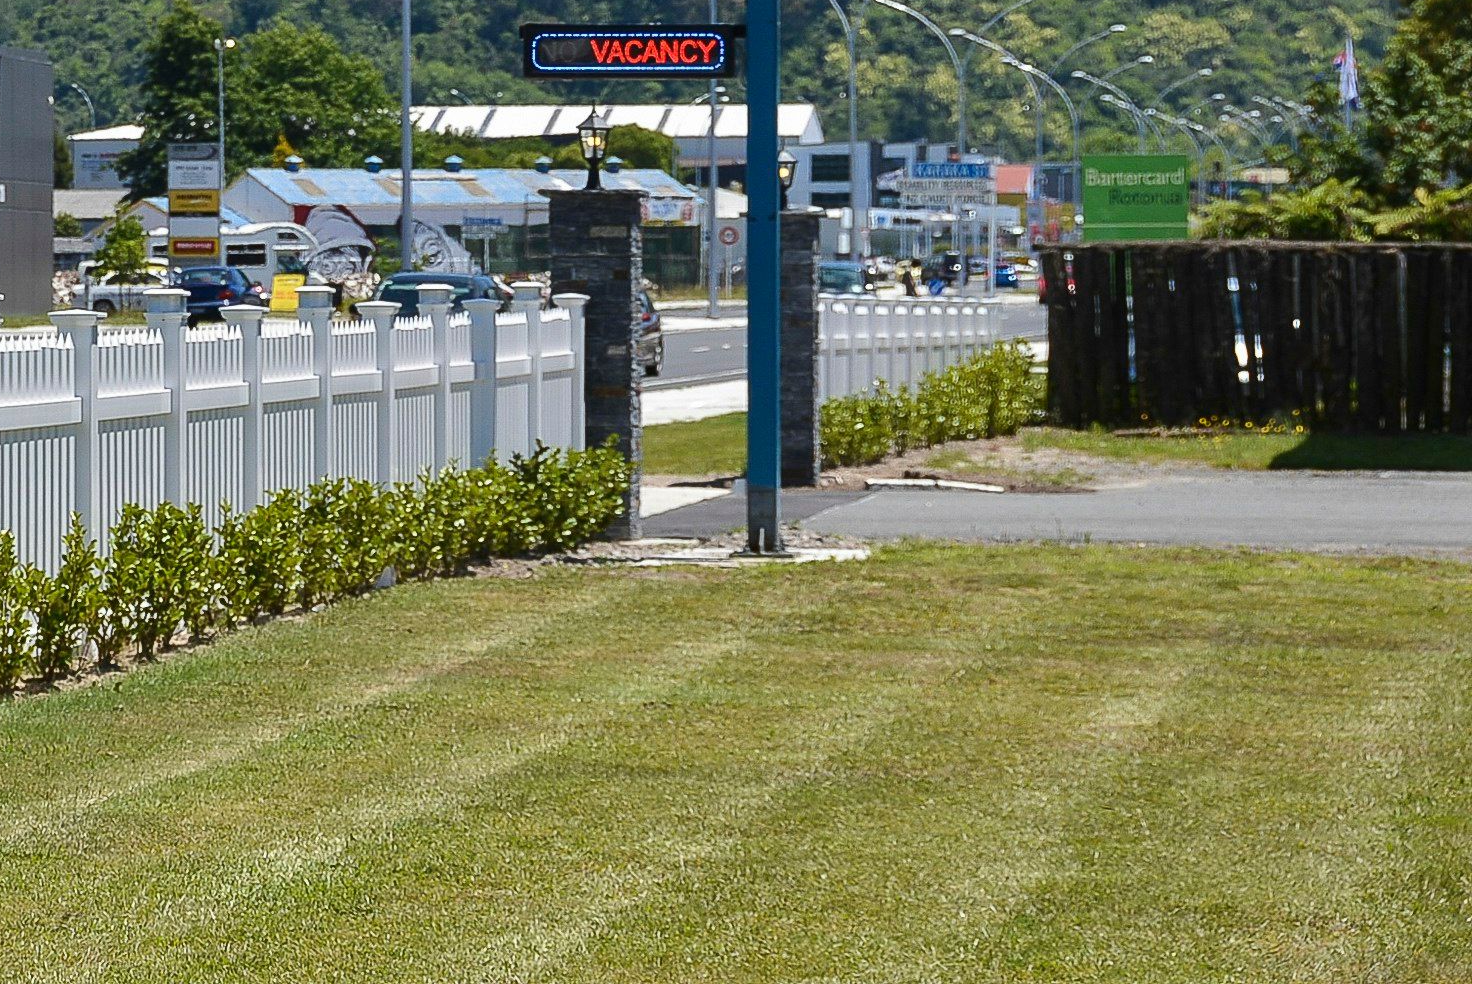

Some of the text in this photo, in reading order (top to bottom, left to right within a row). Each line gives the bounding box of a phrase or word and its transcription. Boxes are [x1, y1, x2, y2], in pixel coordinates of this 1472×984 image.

[590, 39, 716, 64] VACANCY
[1085, 167, 1186, 187] Bartercard
[1108, 188, 1184, 206] Rotorua
